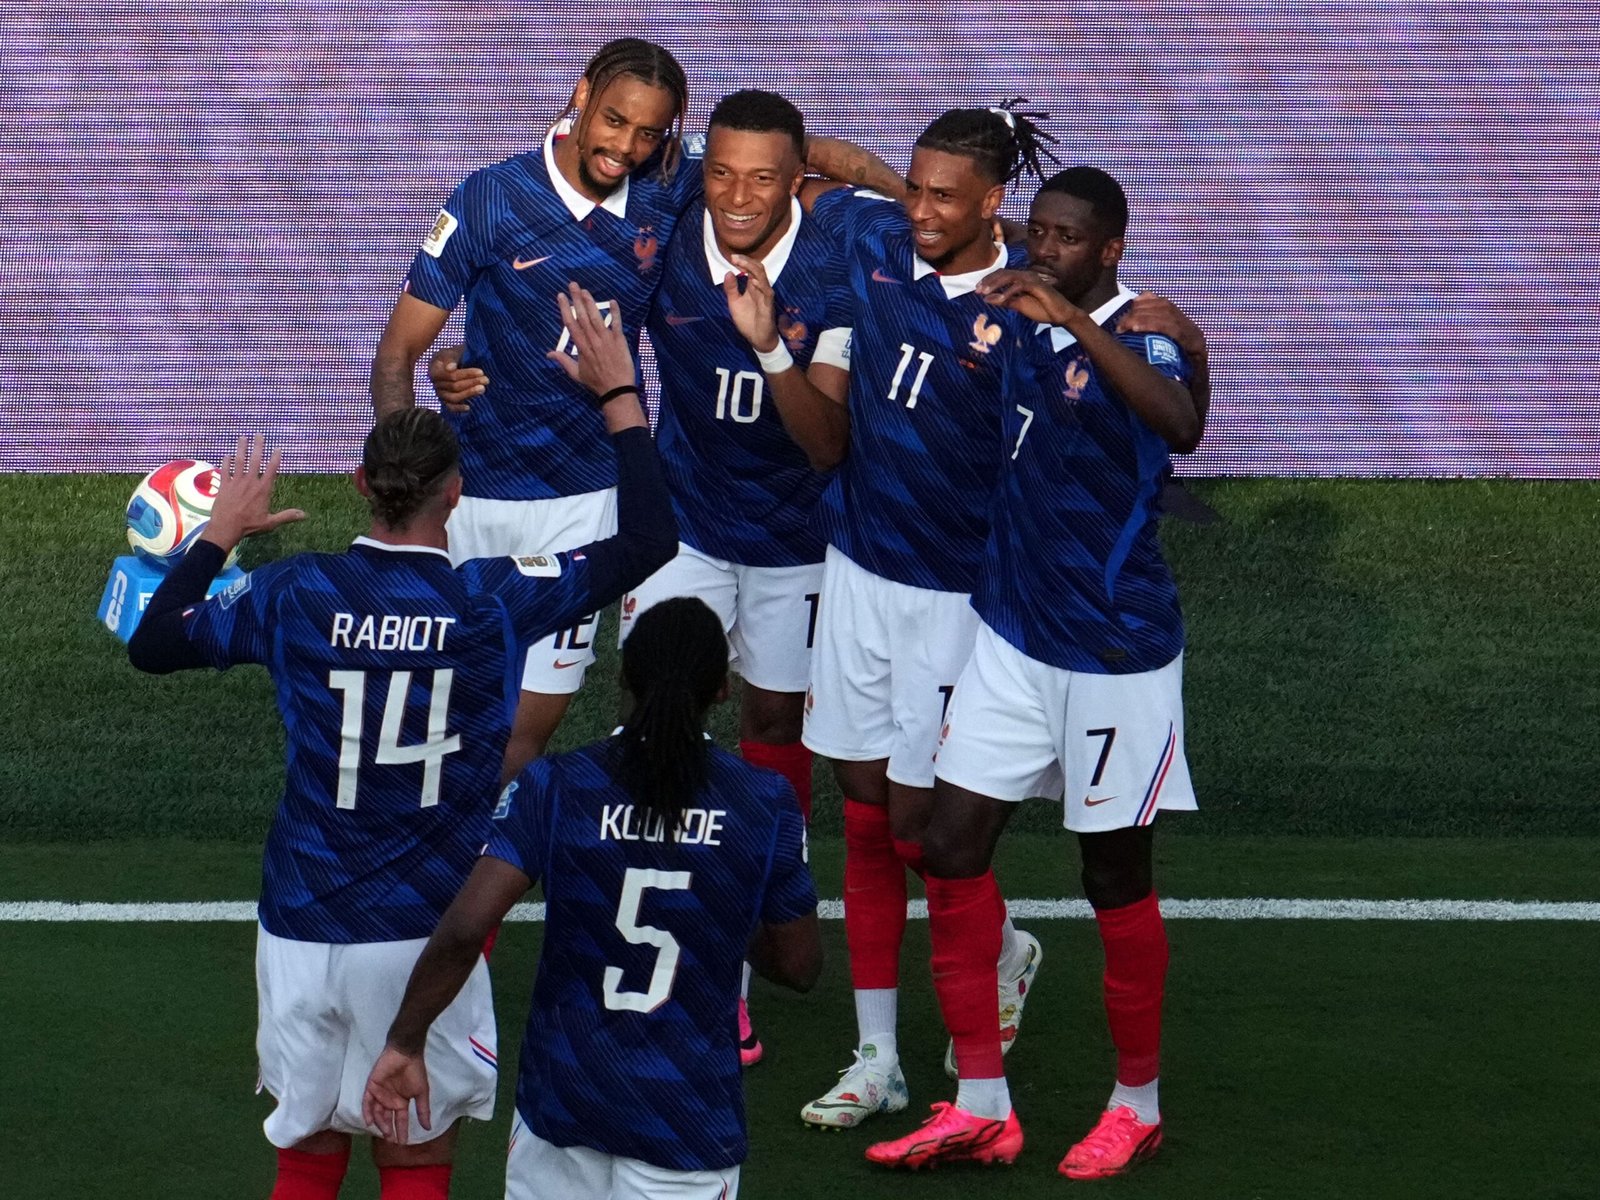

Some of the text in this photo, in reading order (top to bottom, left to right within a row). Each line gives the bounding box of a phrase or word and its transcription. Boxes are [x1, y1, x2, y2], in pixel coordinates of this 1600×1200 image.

[715, 367, 764, 423] 10
[887, 343, 935, 409] 11
[1011, 403, 1034, 461] 7
[331, 612, 456, 652] RABIOT
[804, 593, 820, 649] 1
[328, 668, 463, 810] 14
[1086, 726, 1116, 787] 7
[603, 867, 692, 1014] 5
